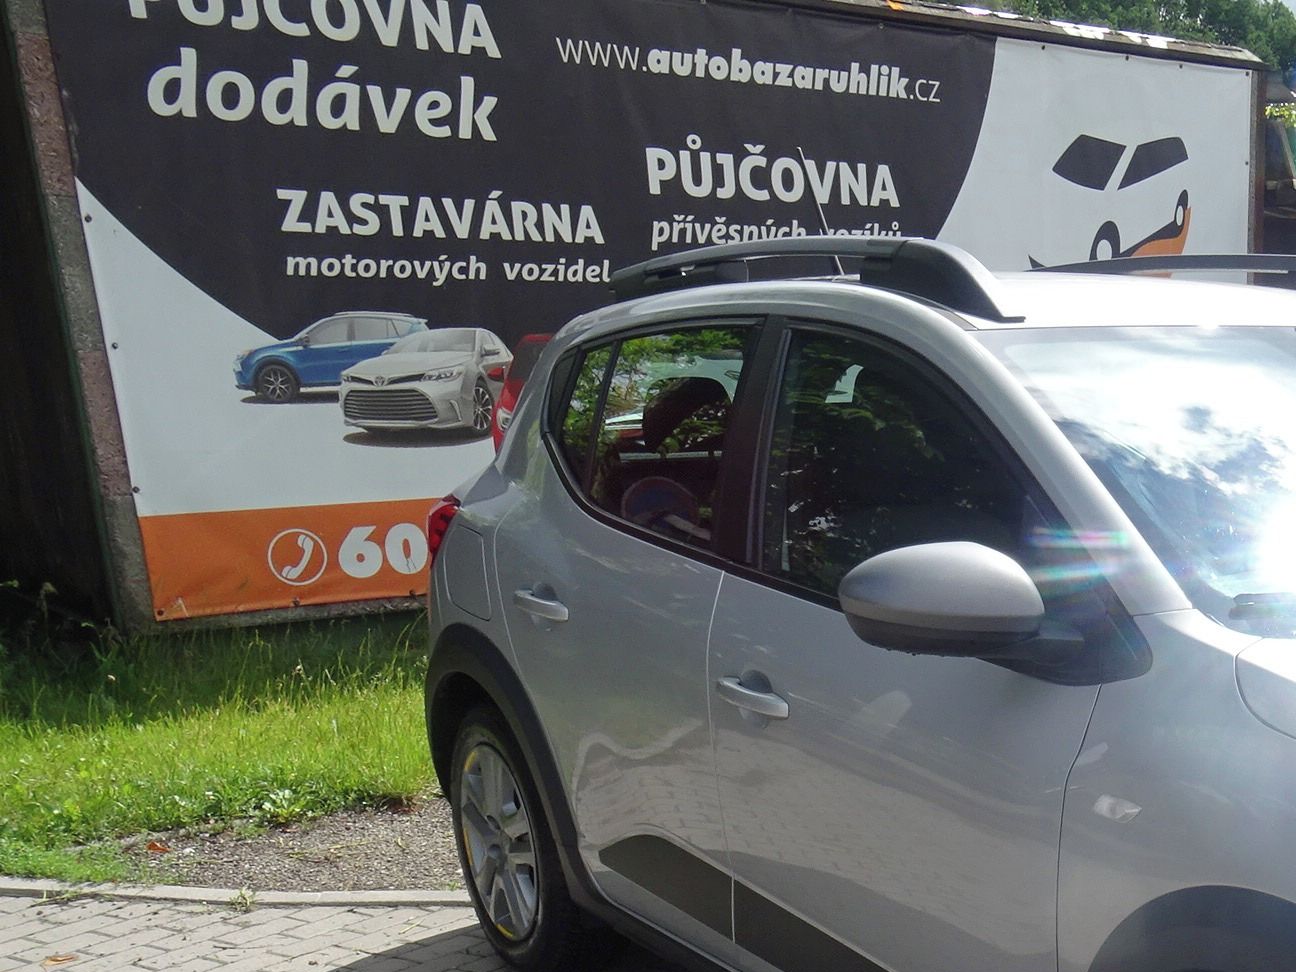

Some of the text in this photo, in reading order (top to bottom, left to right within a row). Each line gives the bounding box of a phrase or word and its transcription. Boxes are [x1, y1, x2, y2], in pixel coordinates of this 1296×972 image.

[146, 46, 498, 142] dodávek
[555, 36, 941, 102] www.autobazaruhlik.cz
[645, 133, 901, 208] PŮJČOVNA
[275, 189, 605, 245] ZASTAVÁRNA
[286, 254, 611, 287] motorových vozidel
